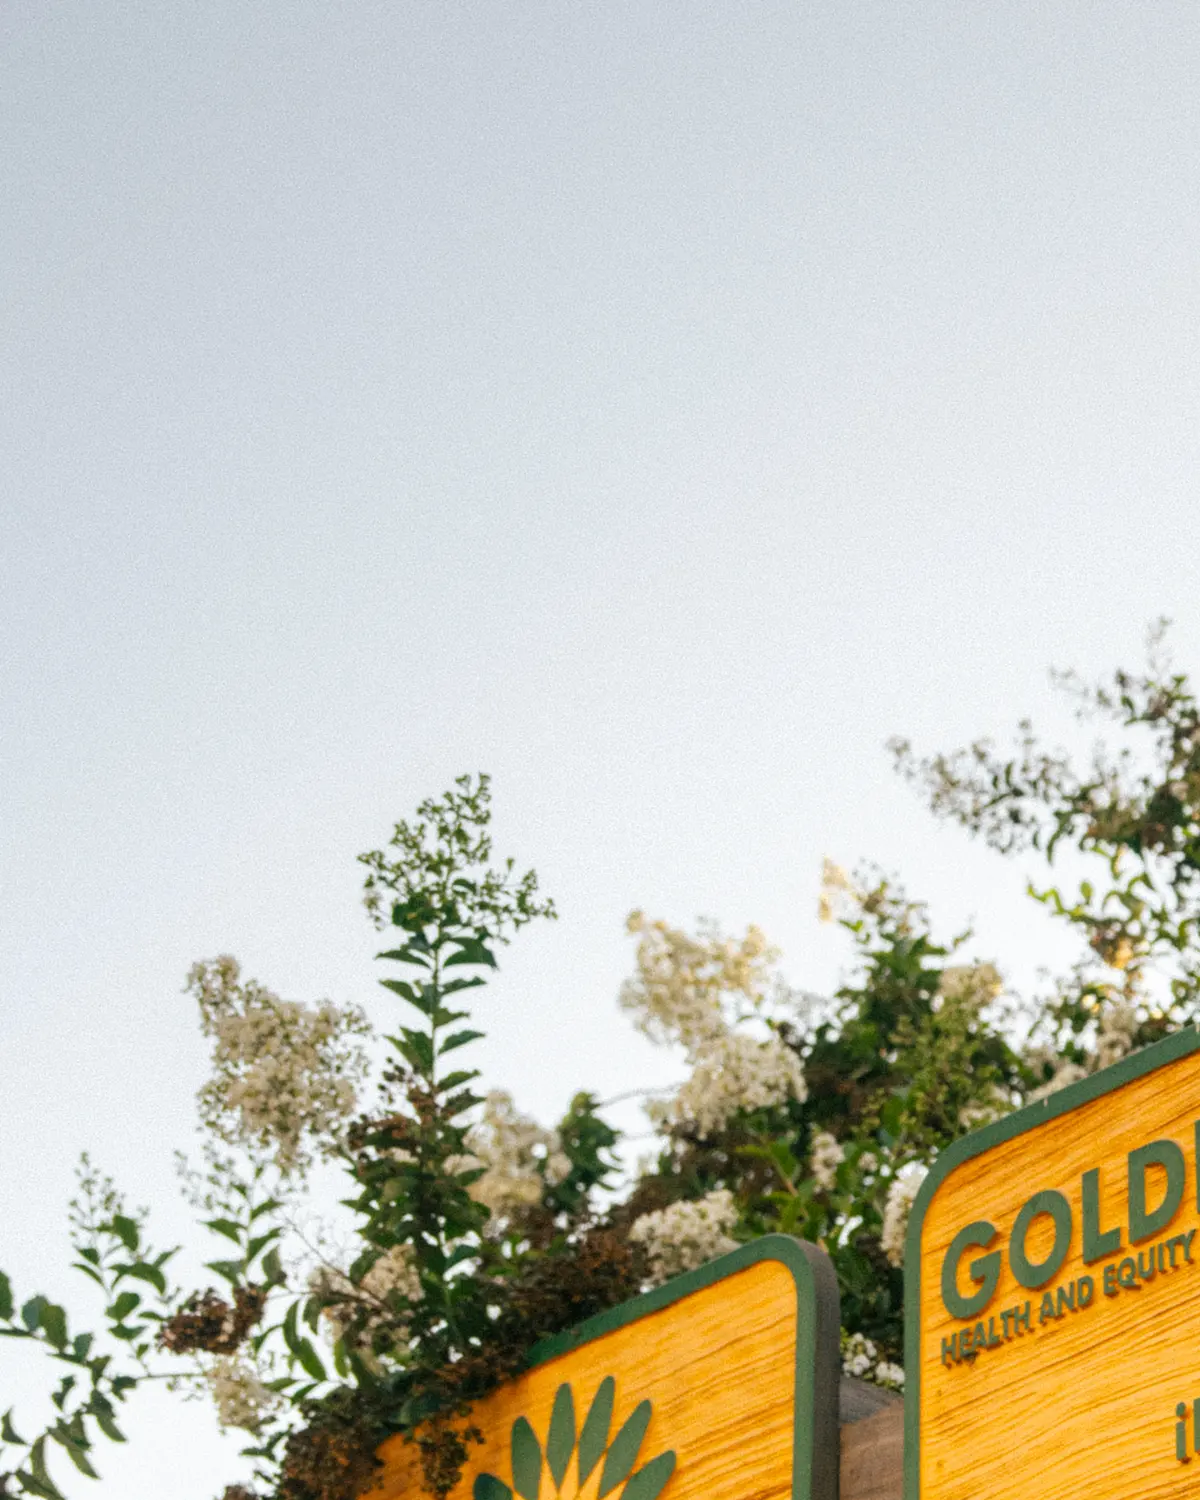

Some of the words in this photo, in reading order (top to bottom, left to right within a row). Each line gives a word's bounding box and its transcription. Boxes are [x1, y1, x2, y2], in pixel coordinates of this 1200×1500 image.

[941, 1302, 1032, 1366] HEALTH
[1039, 1275, 1095, 1321] AND
[1103, 1229, 1197, 1296] EQUITY
